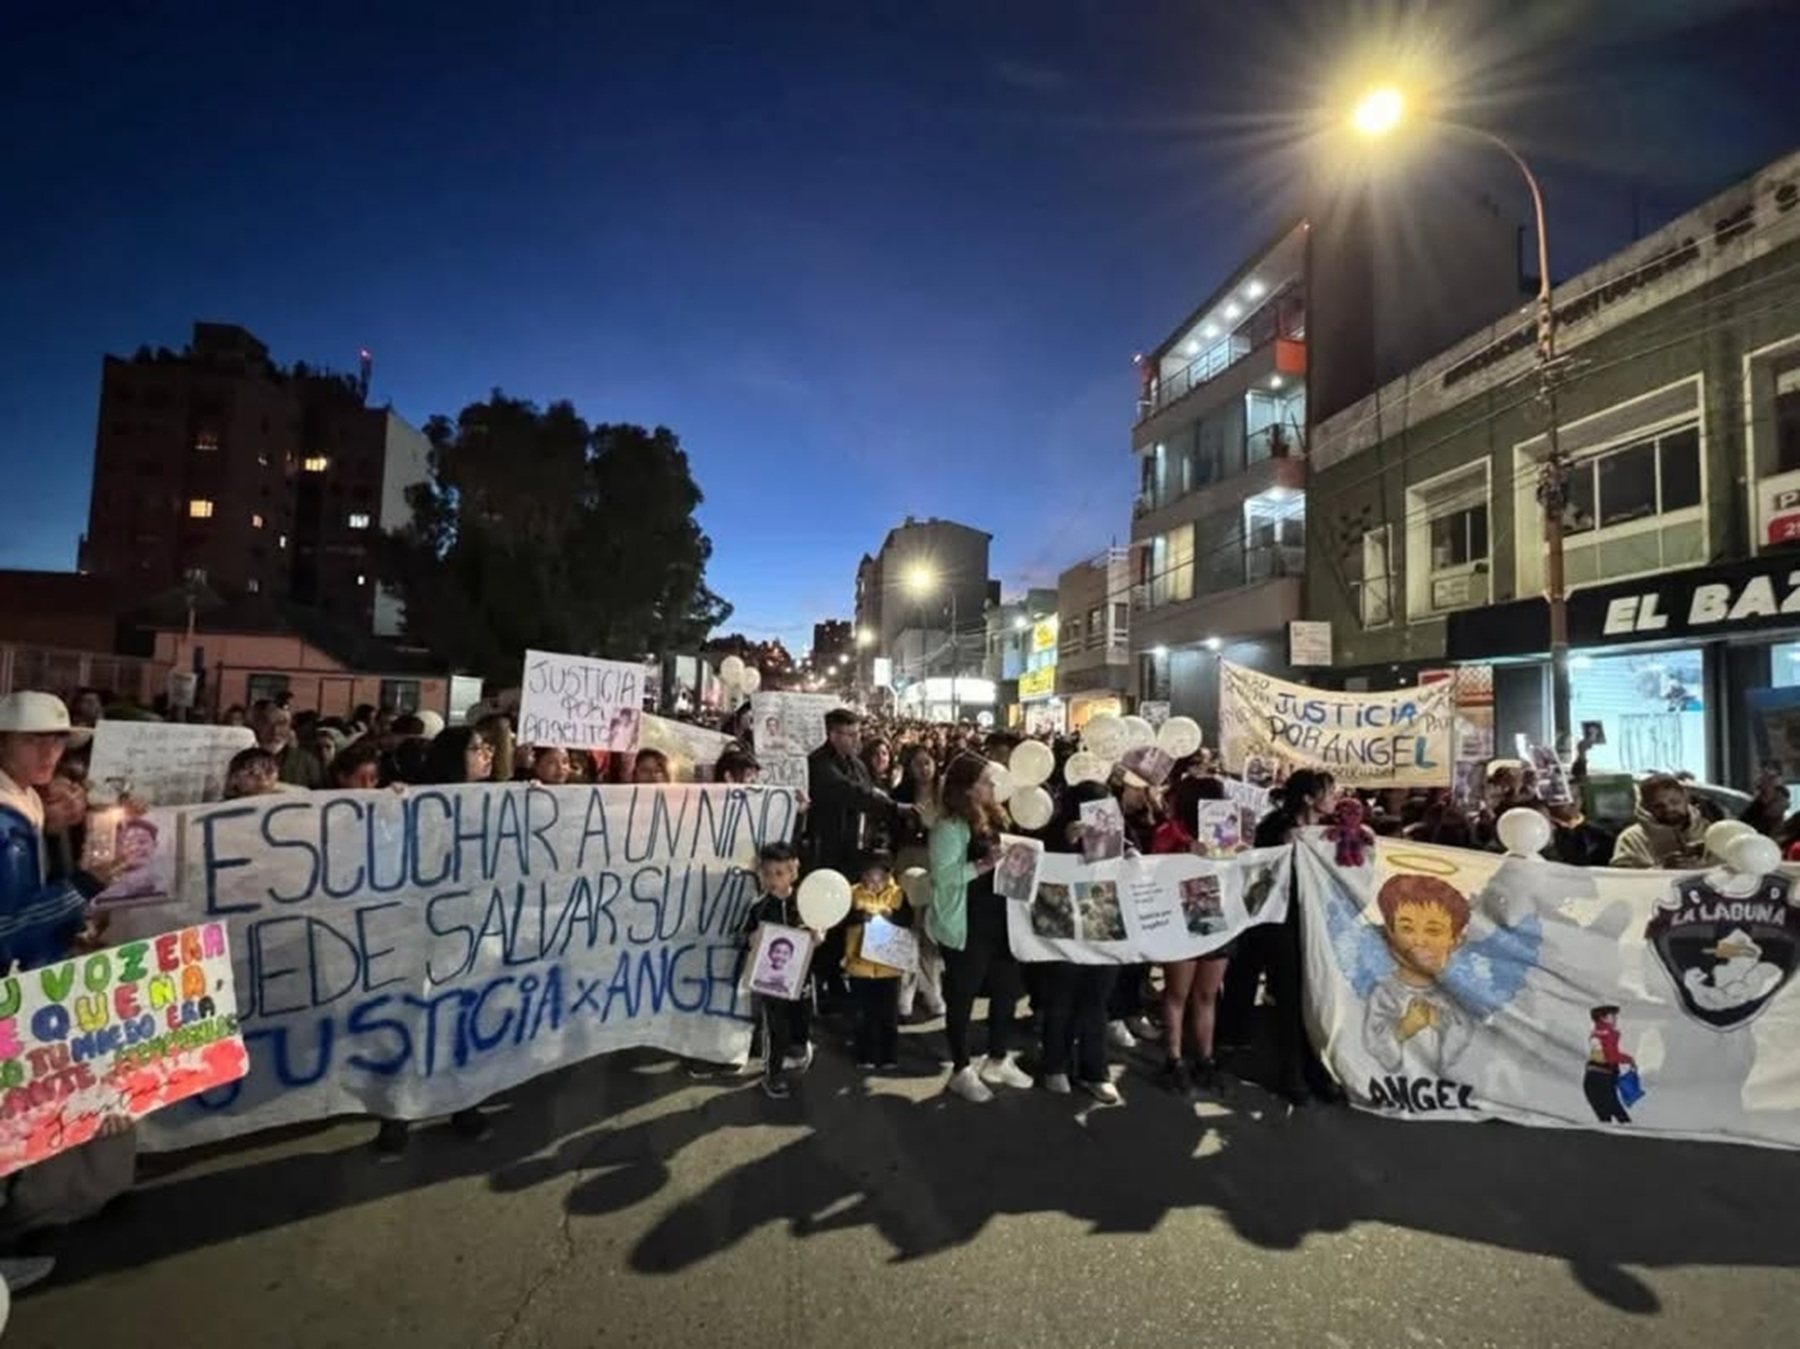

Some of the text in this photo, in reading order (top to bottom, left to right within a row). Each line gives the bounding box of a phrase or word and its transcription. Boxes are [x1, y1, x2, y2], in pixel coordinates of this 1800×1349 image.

[1604, 593, 1669, 635] EL
[529, 660, 635, 706] JUSTICIA
[561, 696, 605, 720] POR
[1267, 715, 1322, 750] POR
[1322, 733, 1438, 769] ANGEL
[192, 784, 560, 917] ESCUCHAR
[577, 786, 611, 869] A
[625, 785, 690, 863] UN
[1670, 906, 1695, 926] LA
[40, 942, 151, 1003] VOZ
[155, 922, 225, 973] ERA
[236, 901, 409, 1023] UEDE
[425, 870, 617, 987] SALVAR
[627, 864, 692, 944] SU
[600, 942, 757, 1024] ANGEL
[26, 1041, 70, 1077] TU
[70, 1013, 156, 1063] MIEDO
[166, 995, 216, 1031] ERA
[1368, 1075, 1482, 1114] ANGEL
